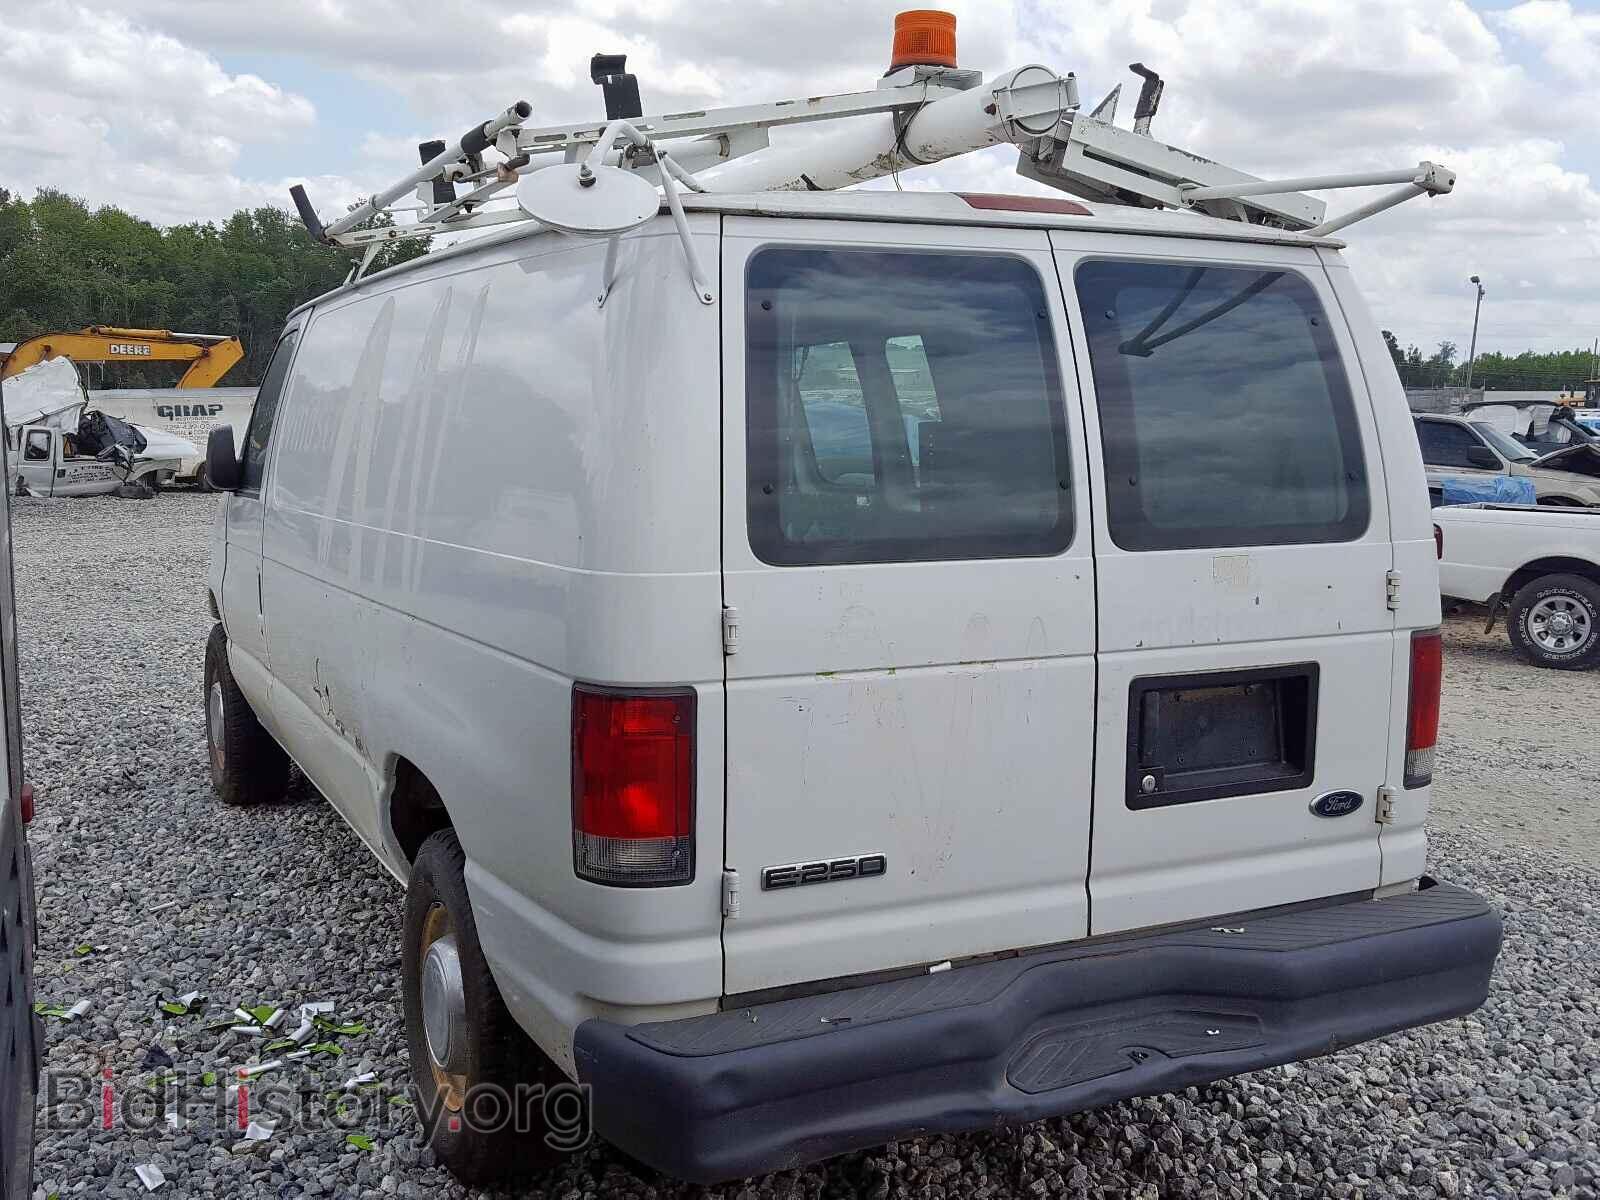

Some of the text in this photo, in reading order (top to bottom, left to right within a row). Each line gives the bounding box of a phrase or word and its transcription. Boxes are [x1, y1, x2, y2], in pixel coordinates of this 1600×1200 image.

[110, 344, 151, 356] DEERE
[1324, 794, 1354, 812] Ford
[764, 854, 886, 889] E-250
